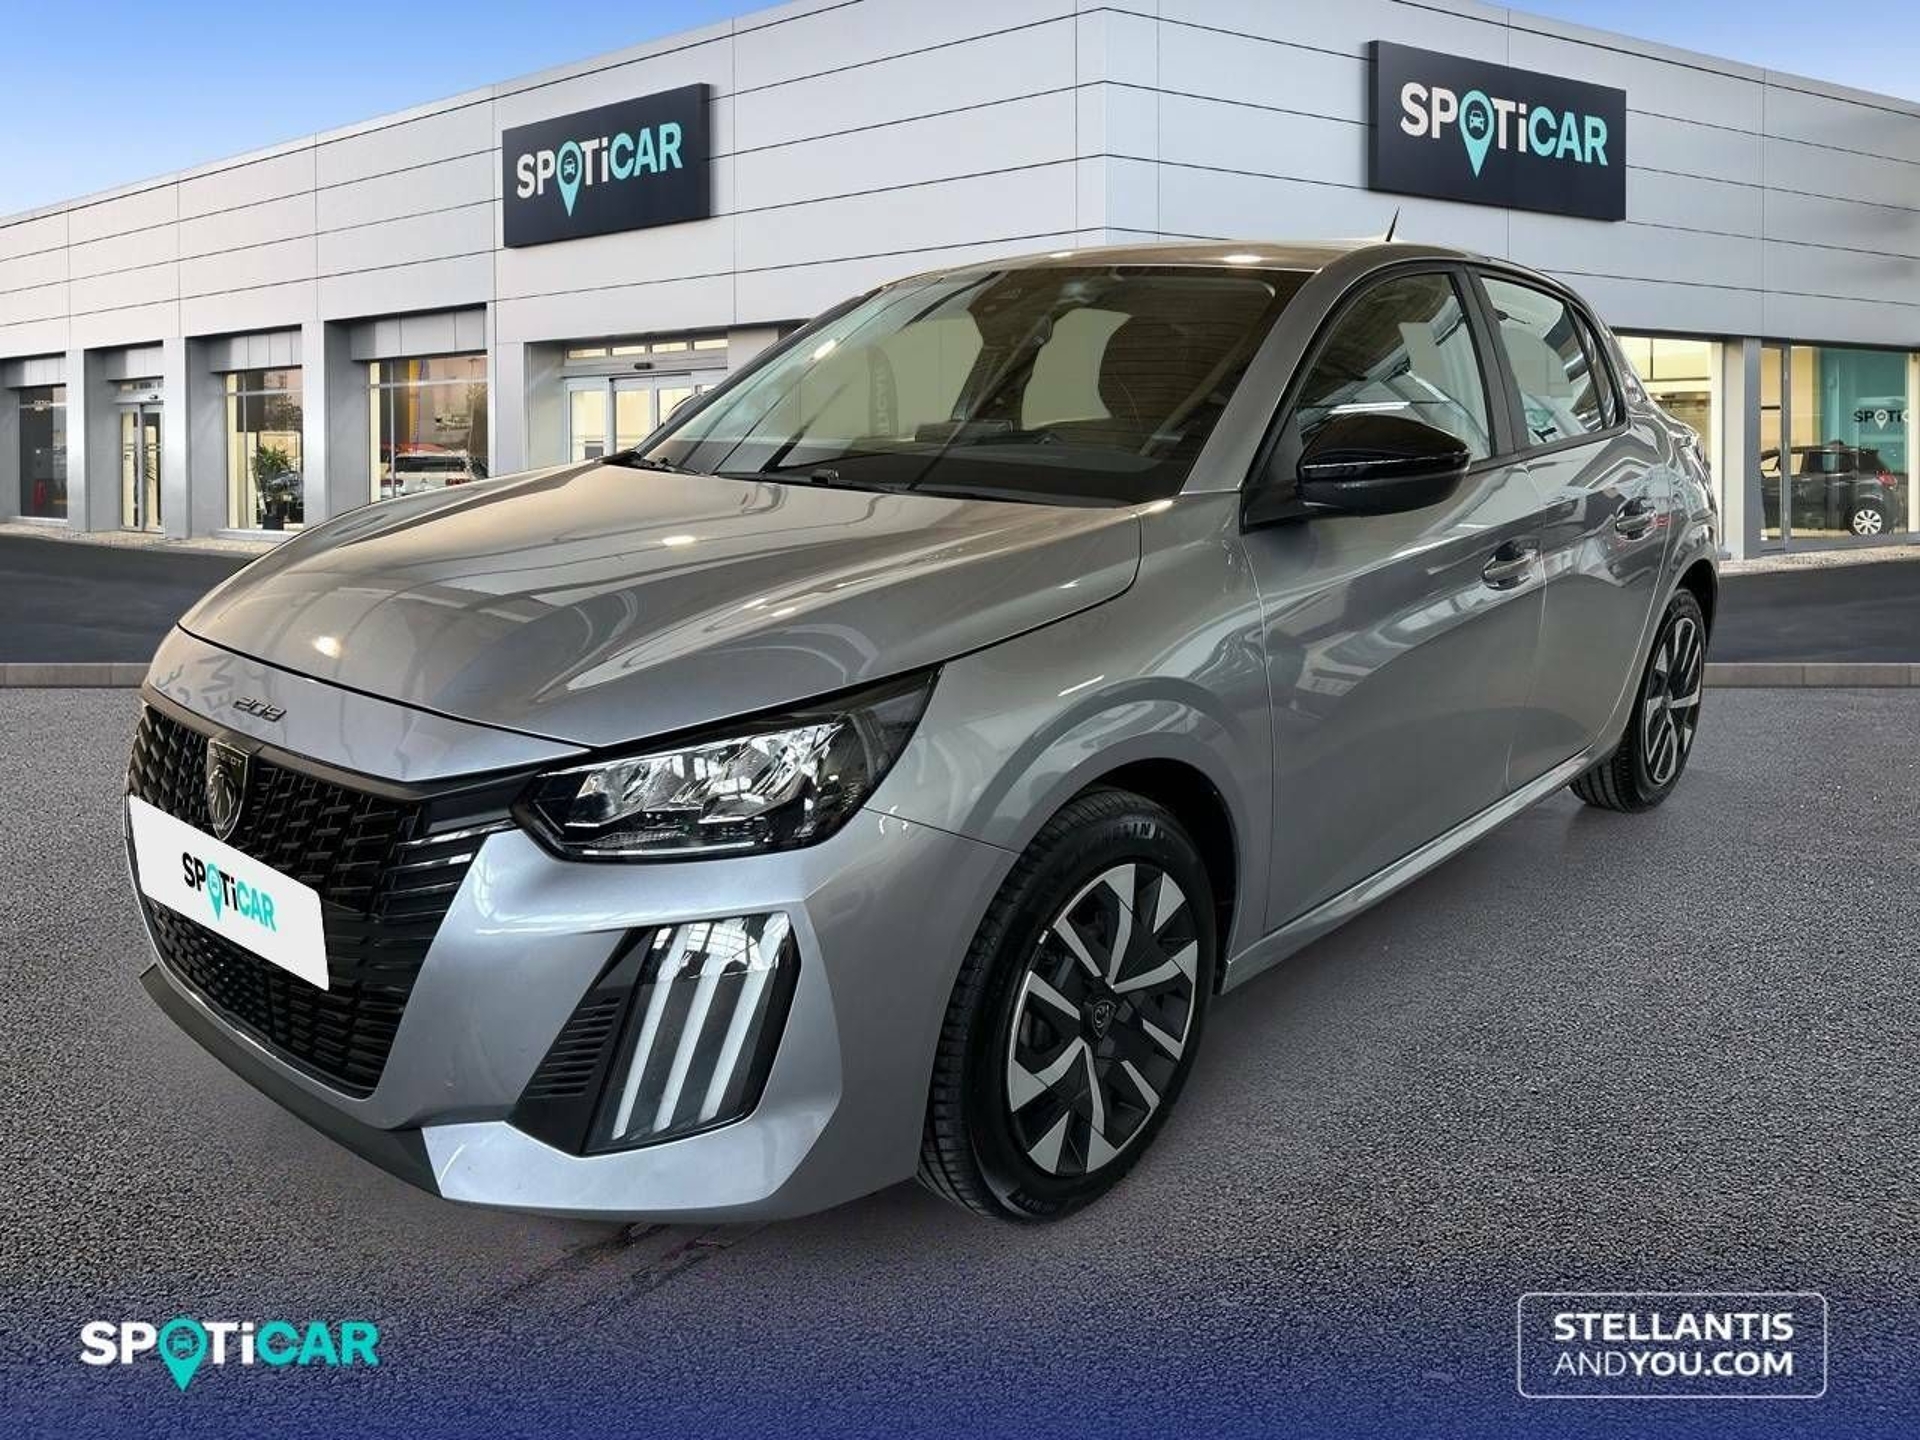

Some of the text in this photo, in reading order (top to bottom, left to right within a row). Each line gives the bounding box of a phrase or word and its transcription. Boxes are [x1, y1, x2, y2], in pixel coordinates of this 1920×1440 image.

[517, 122, 683, 217] SPOTiCAR
[1400, 82, 1609, 178] SPOTiCAR
[182, 852, 277, 931] SPOTiCAR
